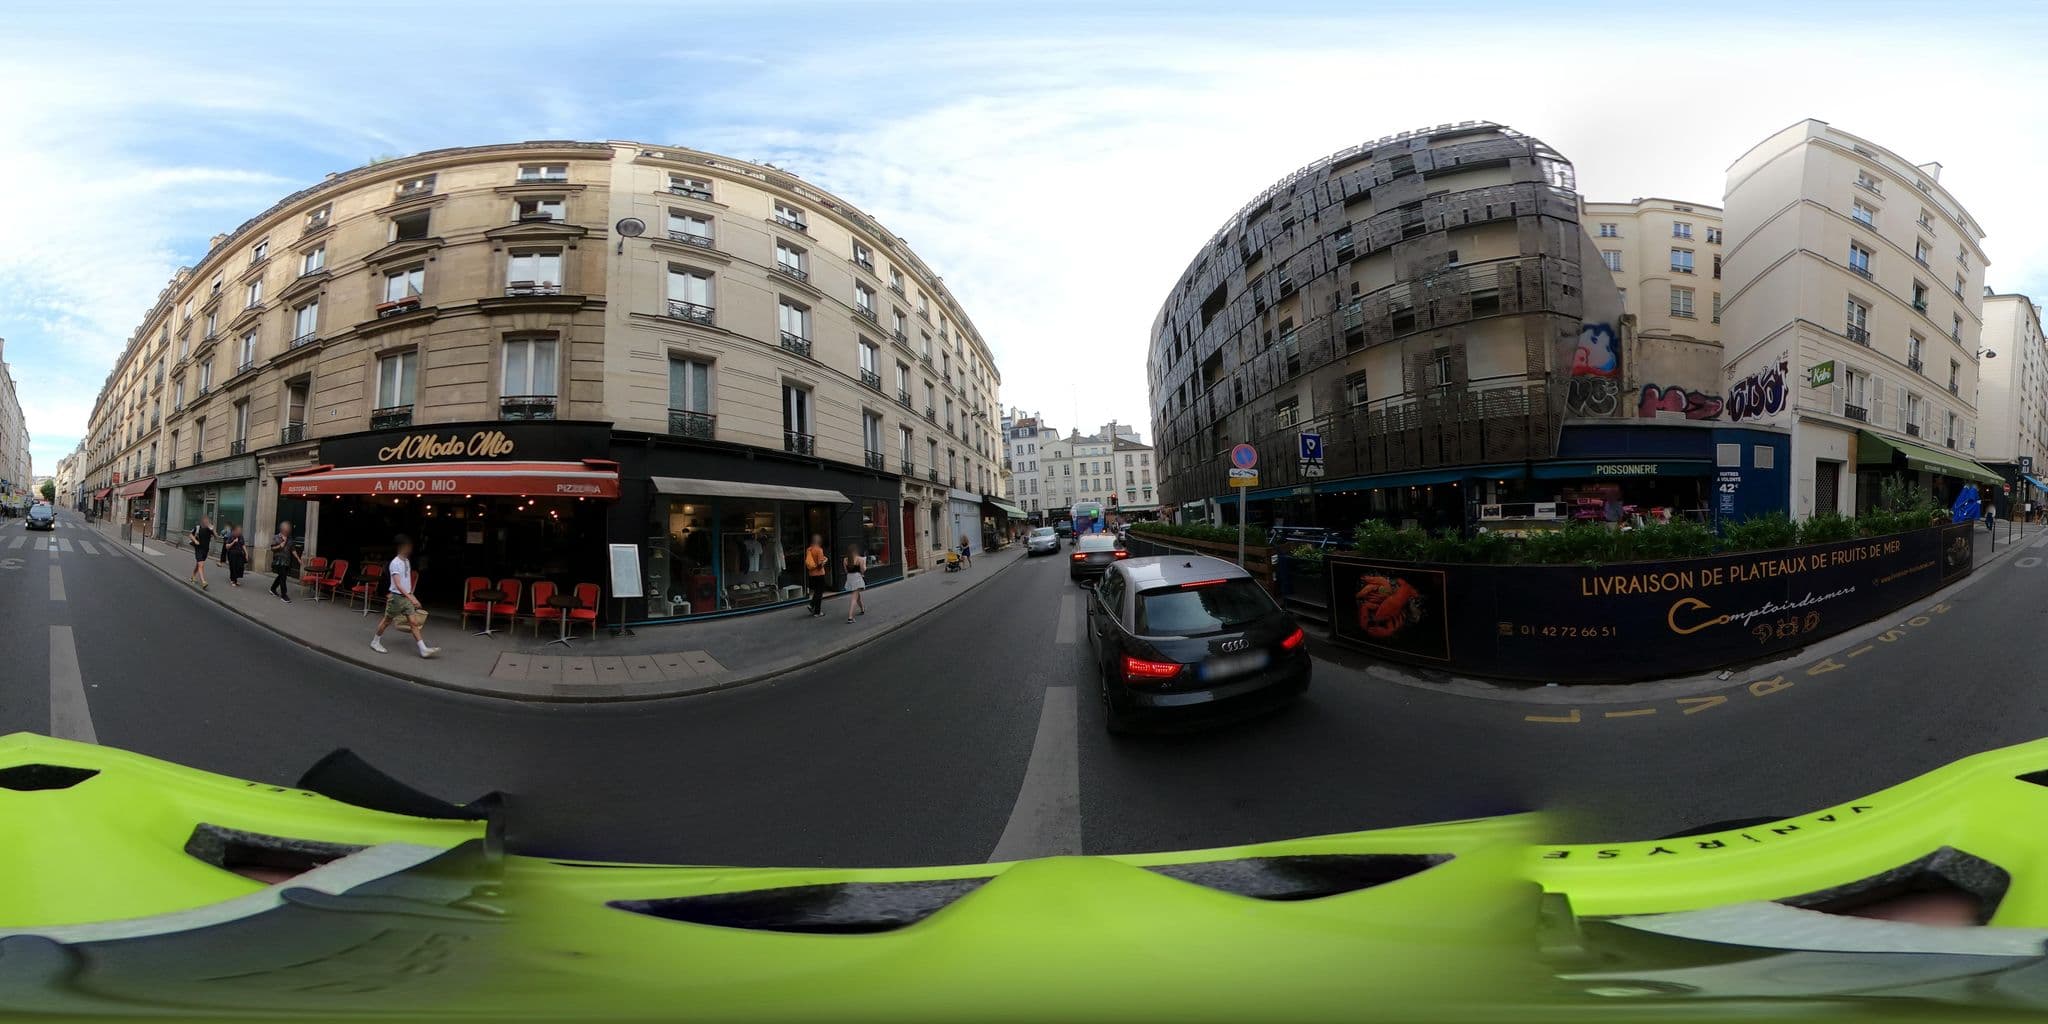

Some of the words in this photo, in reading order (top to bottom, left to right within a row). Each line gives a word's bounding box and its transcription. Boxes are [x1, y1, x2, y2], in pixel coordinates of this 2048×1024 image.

[378, 434, 411, 462] A
[406, 434, 465, 460] Modo
[466, 431, 514, 457] Mio
[1596, 465, 1658, 475] POISSONNERIE
[374, 480, 383, 491] A
[388, 480, 425, 491] MODO
[431, 480, 456, 491] MIO
[1581, 570, 1694, 596] LIVRAISON
[1701, 568, 1723, 587] DE
[1730, 557, 1807, 585] PLATEAUX
[1811, 553, 1828, 570] DE
[1831, 547, 1867, 566] FRUITS
[1869, 545, 1881, 559] DE
[1884, 539, 1902, 554] MER
[1521, 625, 1536, 636] 01
[1541, 626, 1557, 637] 42
[1561, 626, 1577, 637] 72
[1581, 626, 1597, 637] 66
[1601, 626, 1617, 636] 51
